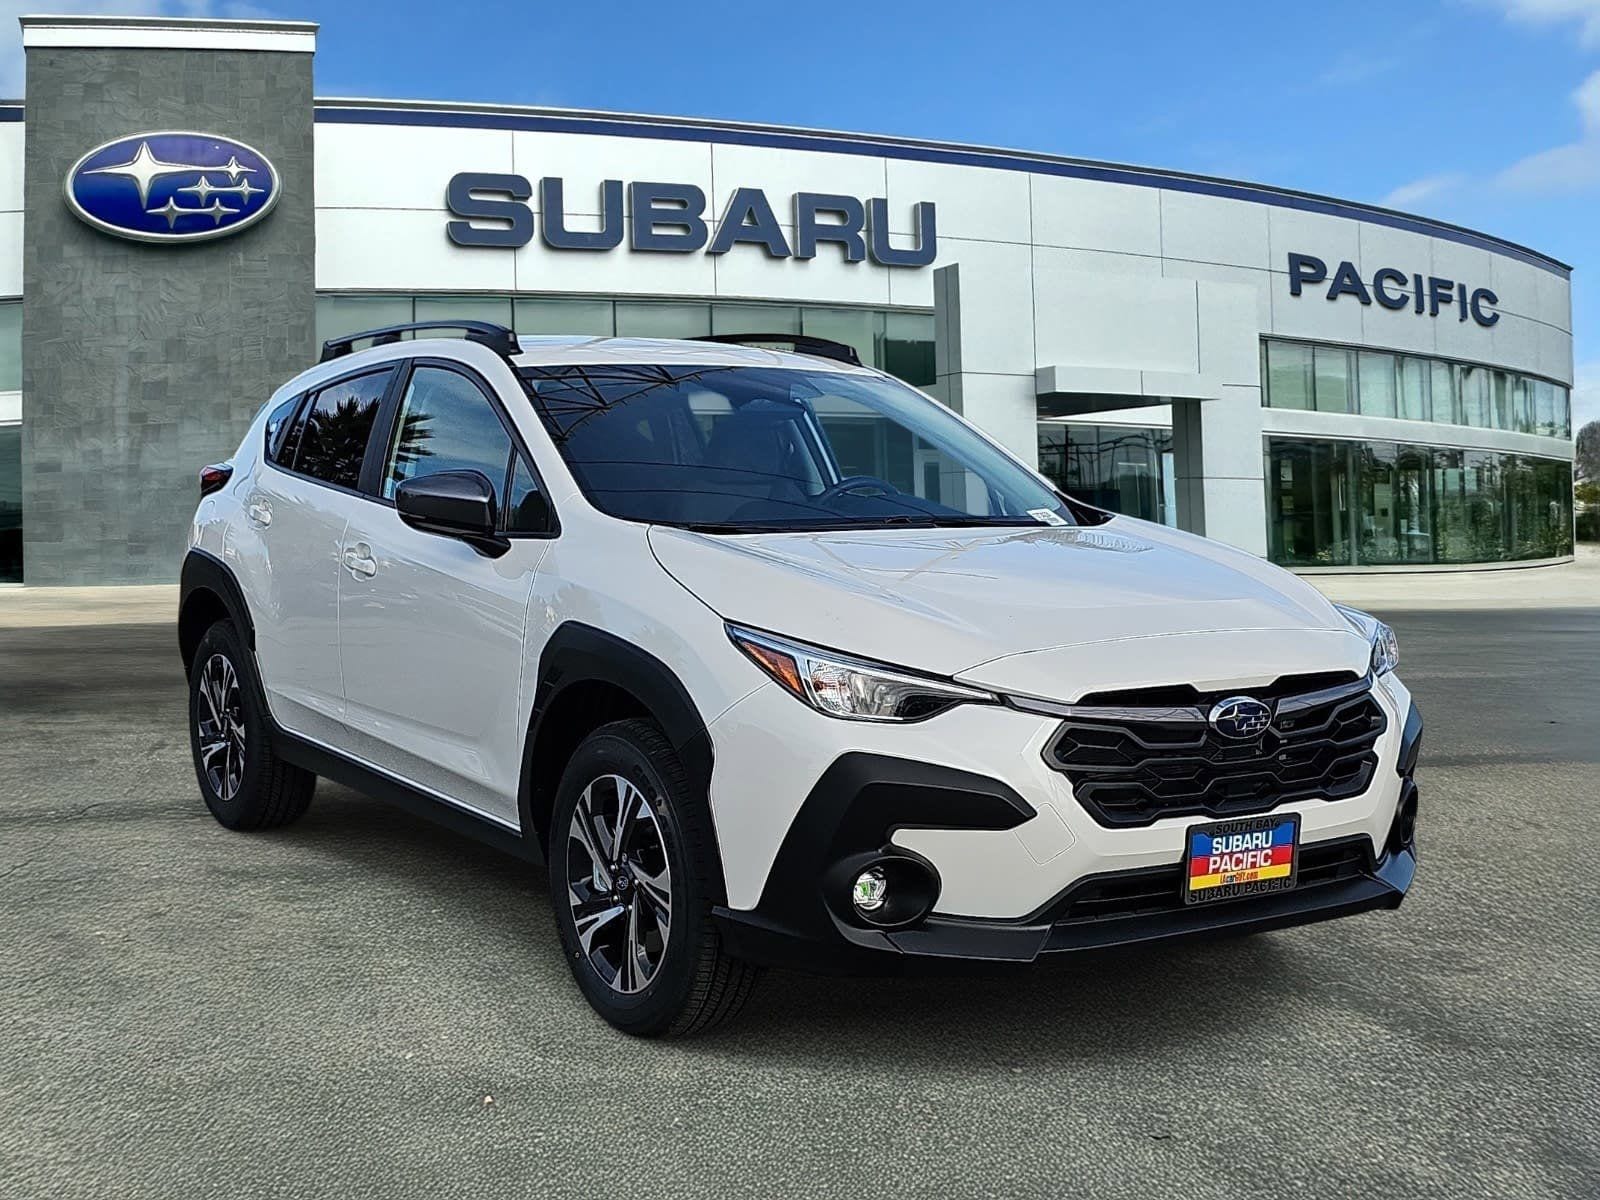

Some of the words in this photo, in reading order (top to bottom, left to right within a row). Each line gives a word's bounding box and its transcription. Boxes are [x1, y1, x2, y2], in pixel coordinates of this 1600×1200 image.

[446, 171, 937, 267] SUBARU
[1288, 252, 1500, 327] PACIFIC
[1216, 822, 1253, 835] SOUTH
[1256, 819, 1276, 829] BAY
[1212, 831, 1272, 855] SUBARU
[1208, 849, 1272, 874] PACIFIC
[1190, 885, 1240, 902] SUBARU
[1245, 878, 1292, 894] PACIFIC
